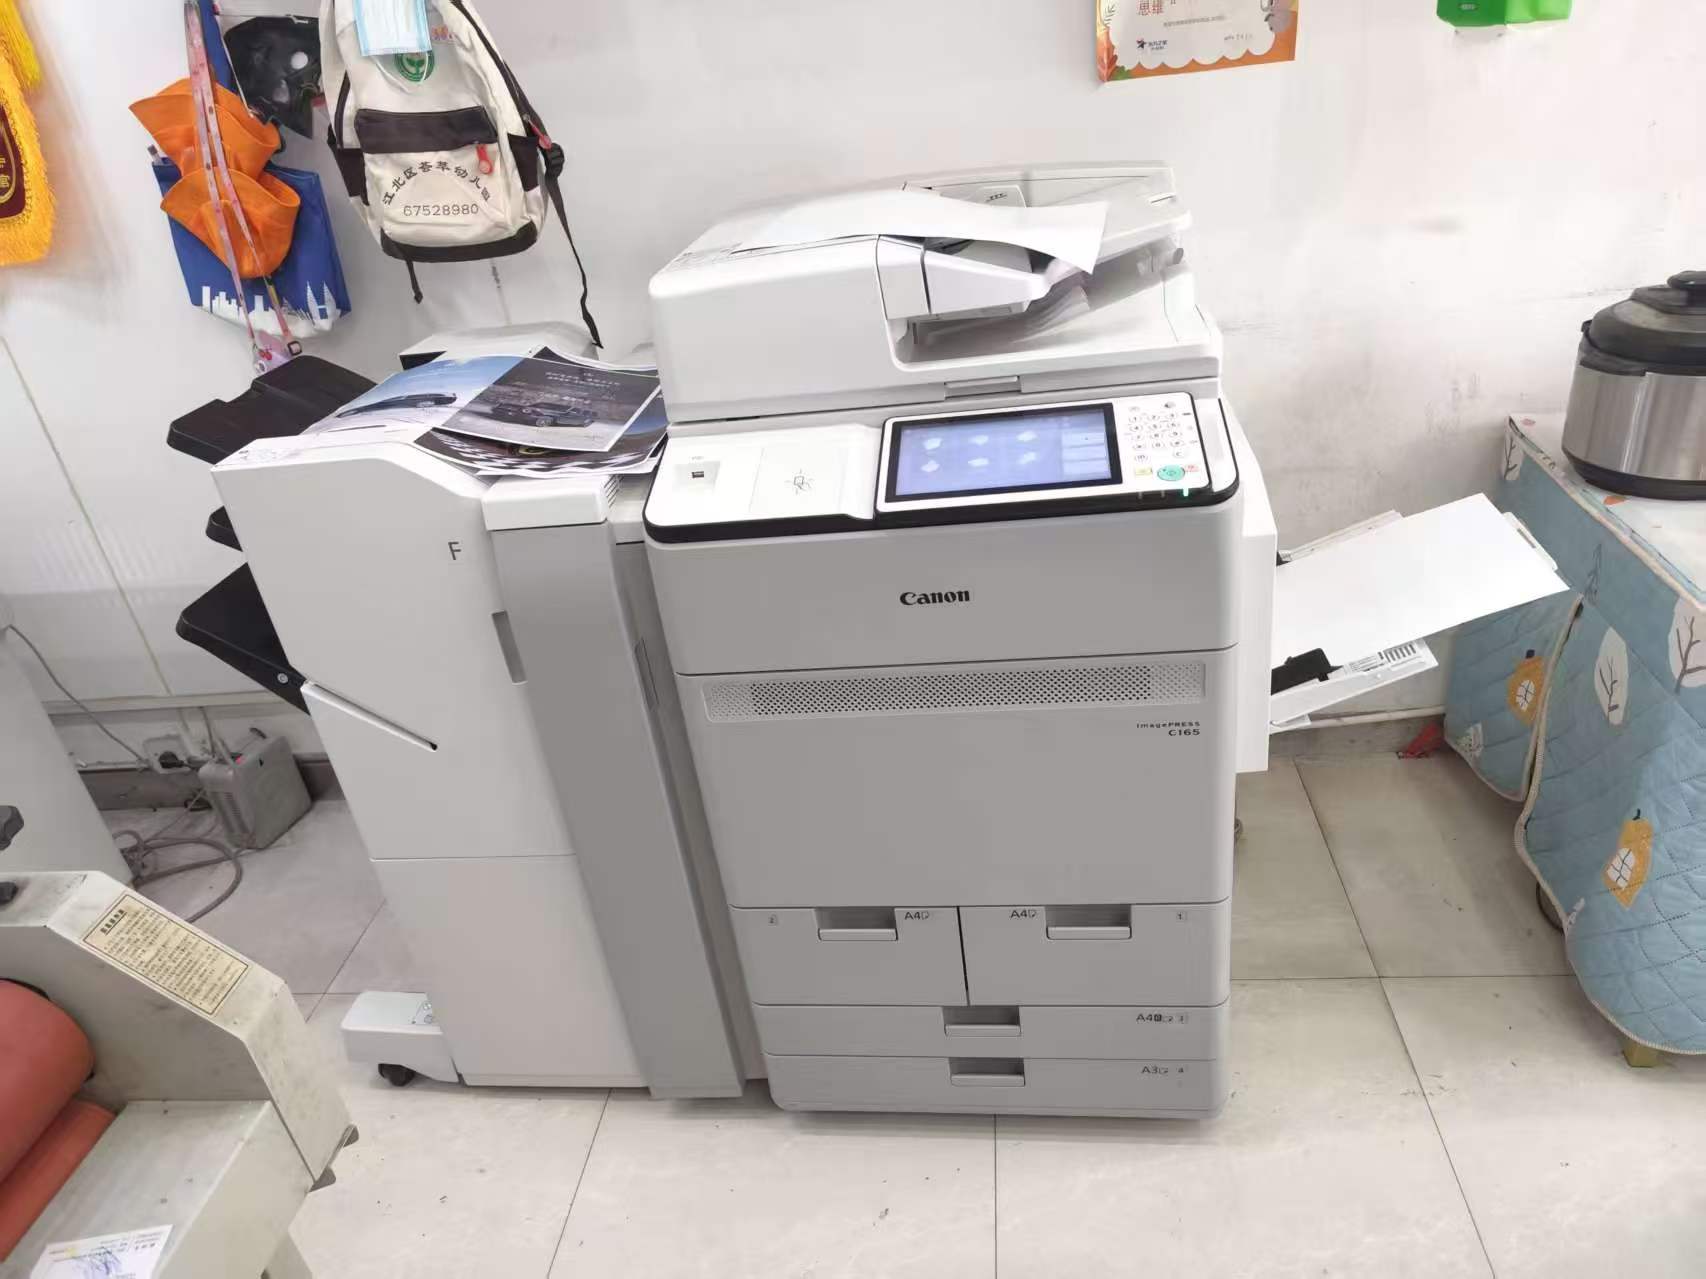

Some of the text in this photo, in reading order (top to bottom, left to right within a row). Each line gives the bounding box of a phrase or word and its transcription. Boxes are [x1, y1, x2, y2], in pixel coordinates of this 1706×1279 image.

[403, 203, 479, 216] 67528980
[448, 541, 461, 561] F
[899, 590, 970, 606] Canon
[1168, 728, 1200, 736] C165
